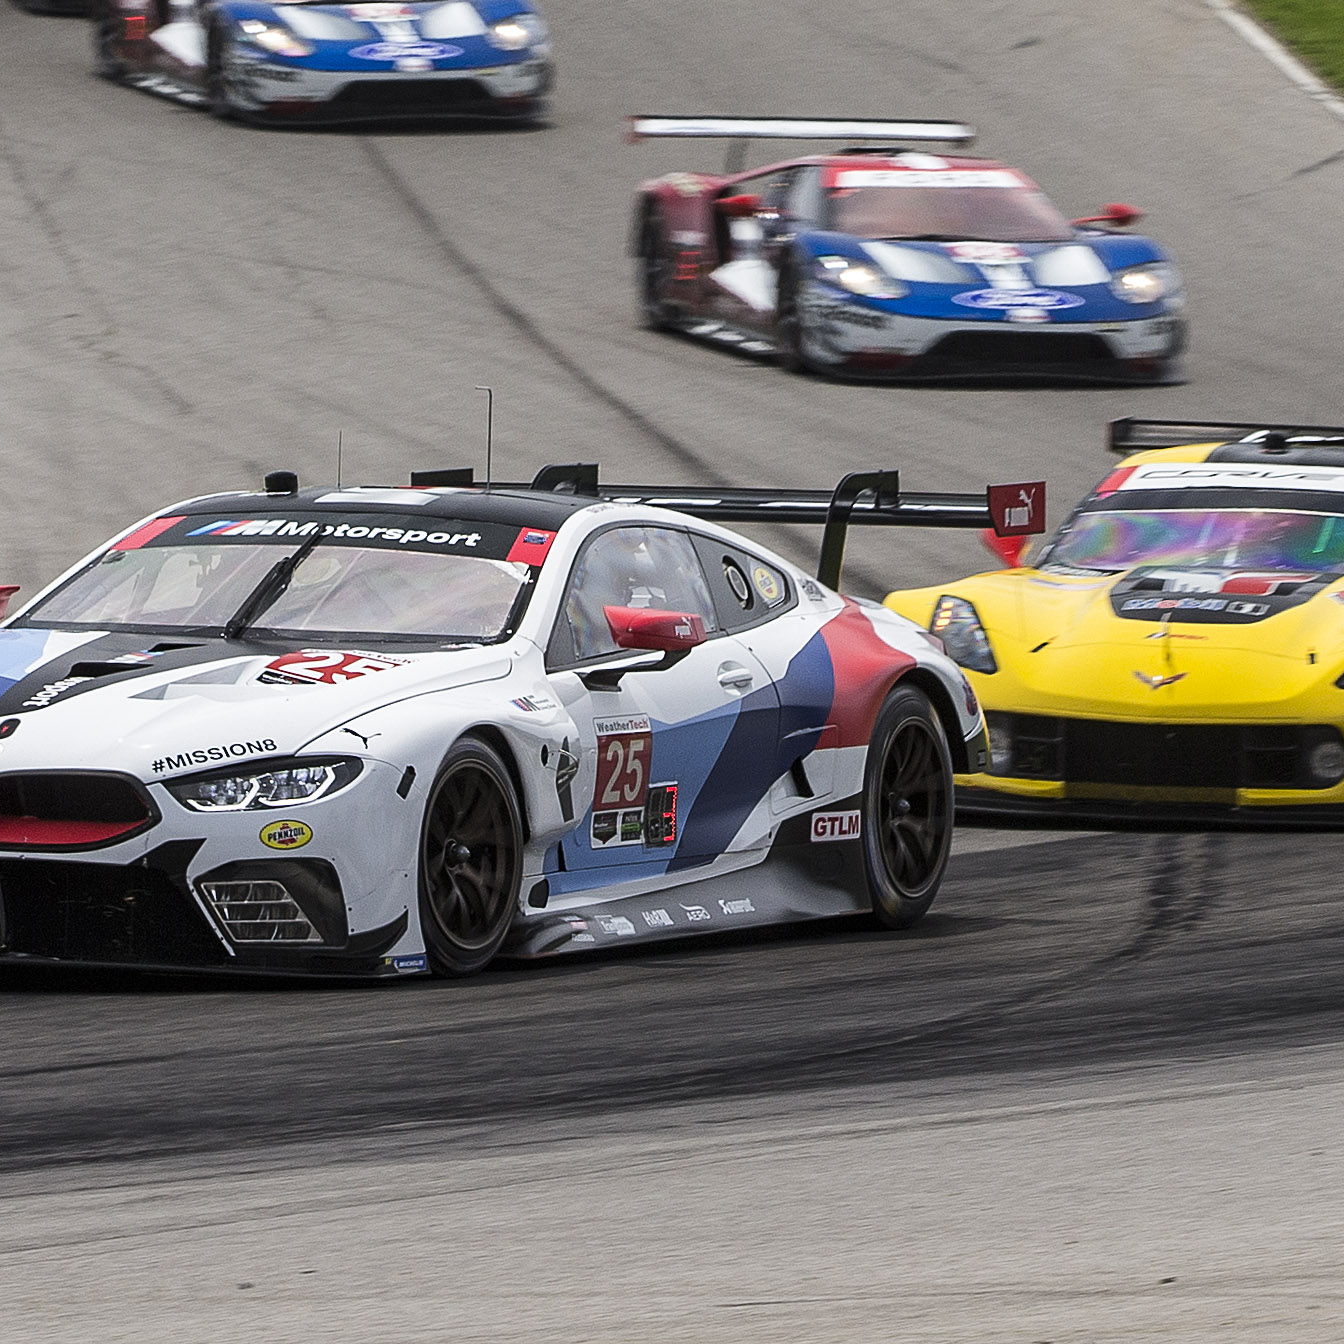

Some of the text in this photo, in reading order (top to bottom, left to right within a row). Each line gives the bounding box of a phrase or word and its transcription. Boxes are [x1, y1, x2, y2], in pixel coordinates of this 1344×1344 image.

[276, 521, 482, 548] Motorsport
[268, 651, 398, 684] 25
[596, 718, 649, 733] WeatherTech
[151, 739, 278, 774] #MISSION8
[601, 739, 645, 804] 25
[267, 827, 306, 842] PENNZOIL
[813, 814, 859, 837] GTLM
